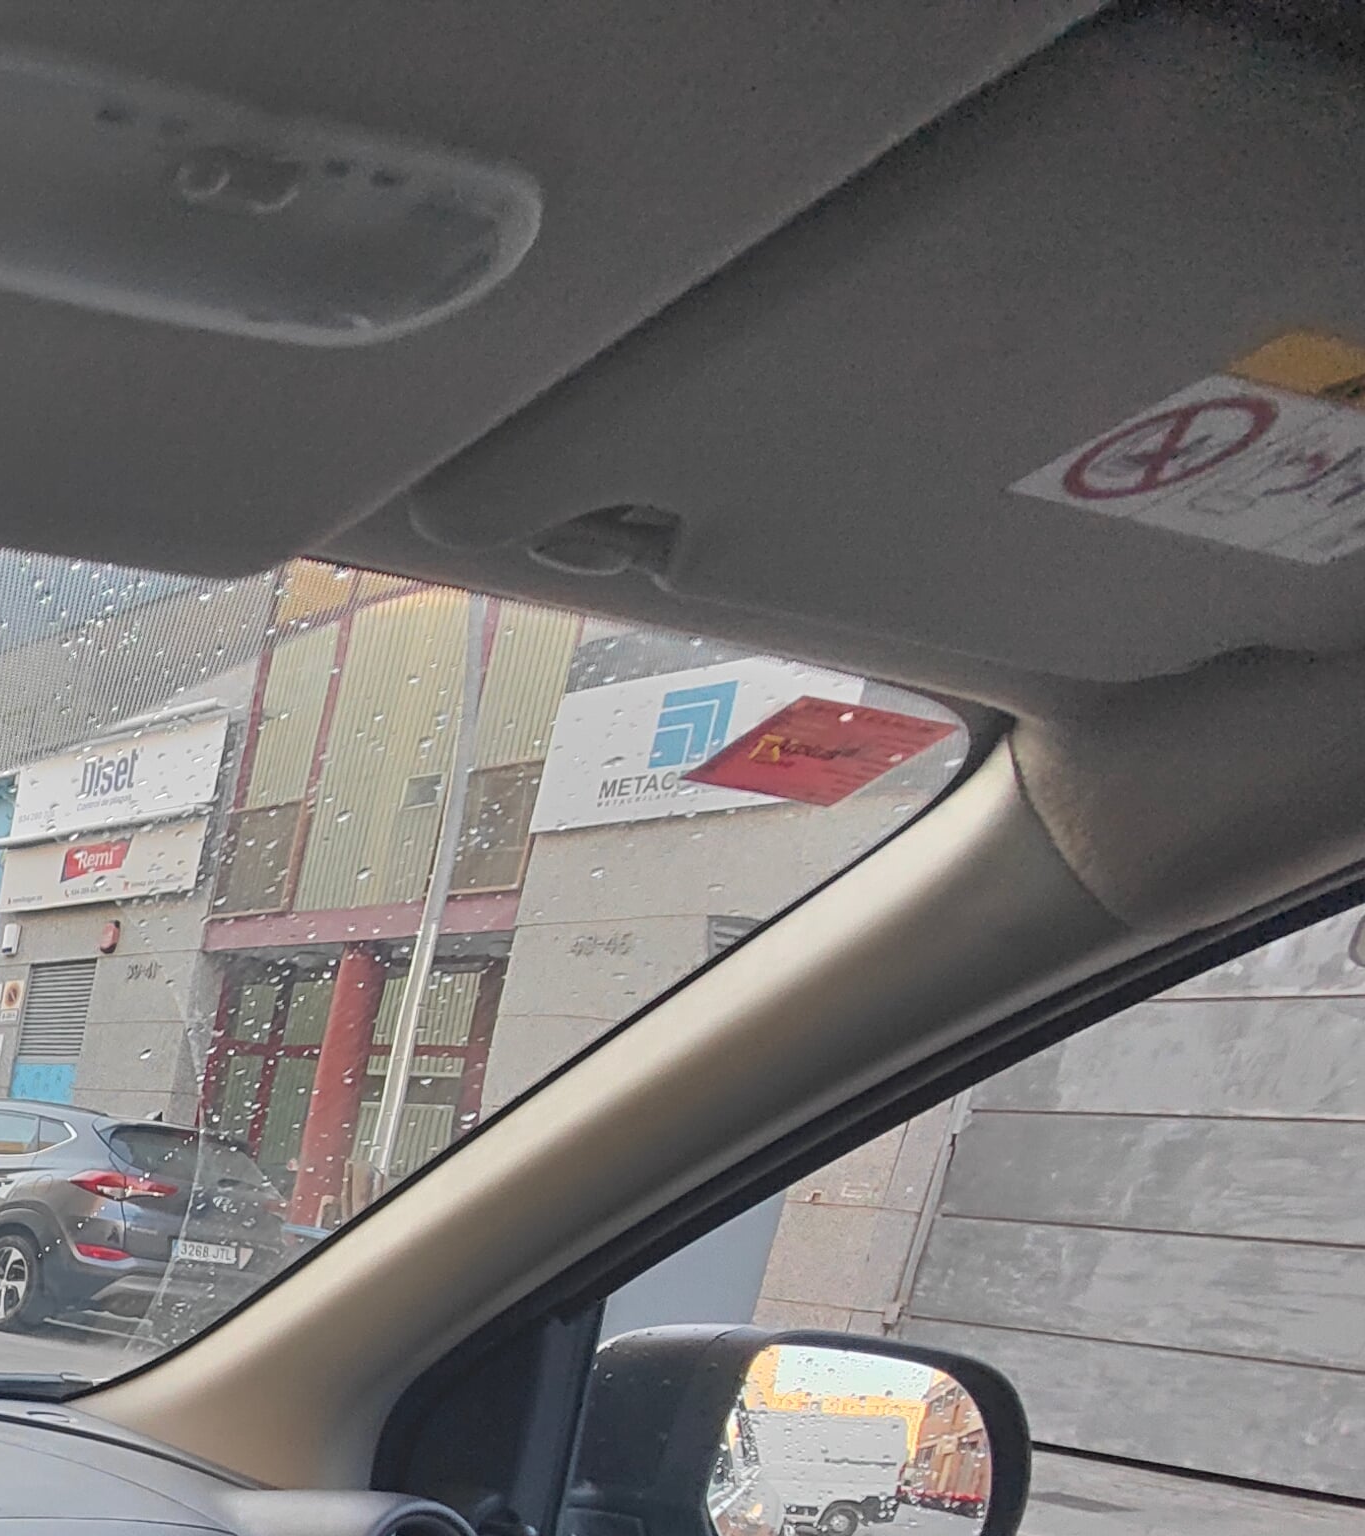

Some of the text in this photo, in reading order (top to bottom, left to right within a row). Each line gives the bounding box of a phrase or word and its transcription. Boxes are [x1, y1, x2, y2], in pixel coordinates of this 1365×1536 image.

[80, 748, 139, 798] Diset
[598, 771, 680, 799] METAC
[77, 851, 114, 870] Remi
[181, 1243, 209, 1258] 3268
